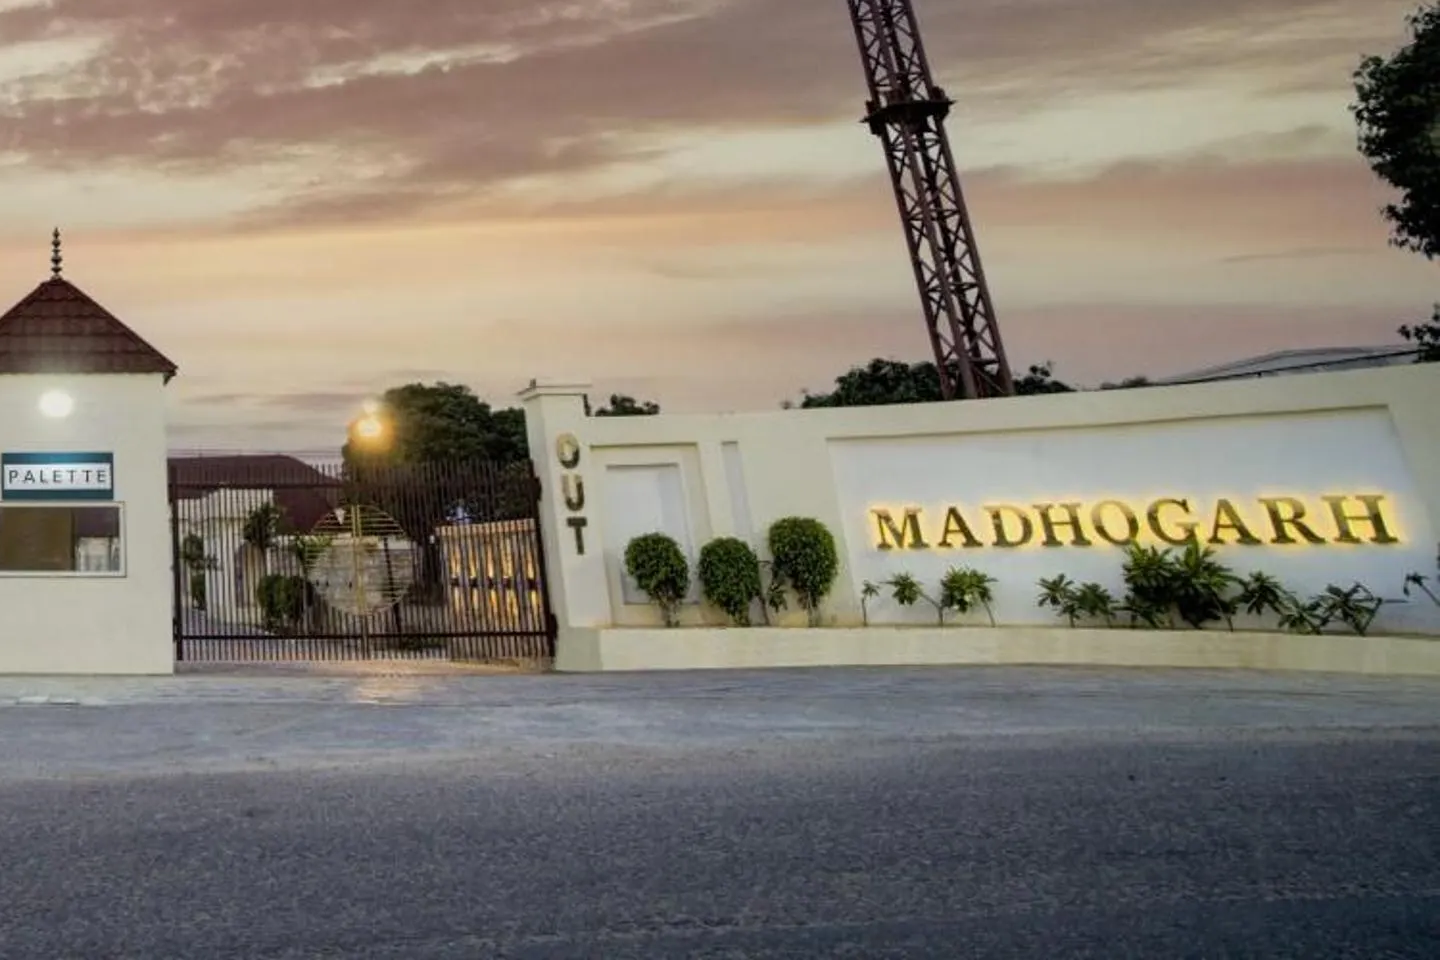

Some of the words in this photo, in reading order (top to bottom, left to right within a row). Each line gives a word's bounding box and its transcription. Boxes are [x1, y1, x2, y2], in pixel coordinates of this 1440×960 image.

[8, 469, 108, 485] PALETTE
[556, 432, 588, 556] OUT
[870, 494, 1400, 551] MADHOGARH
